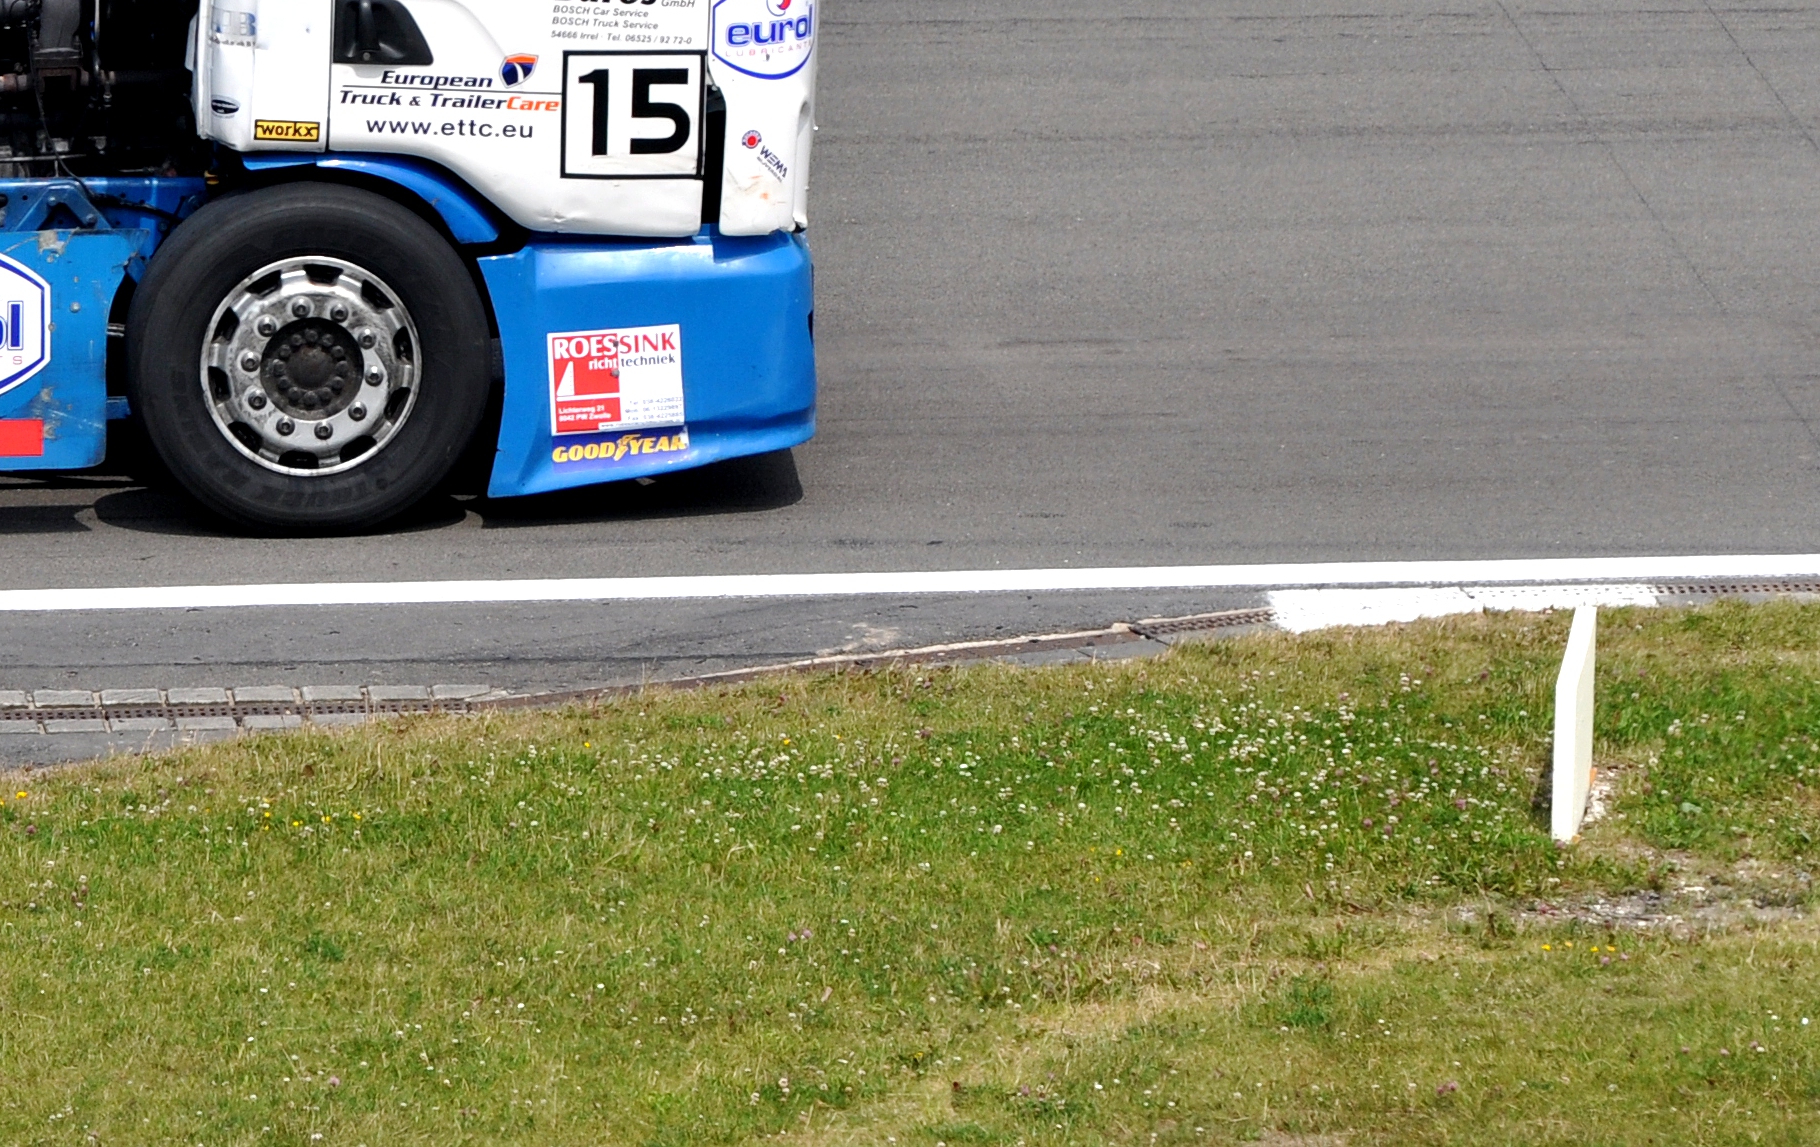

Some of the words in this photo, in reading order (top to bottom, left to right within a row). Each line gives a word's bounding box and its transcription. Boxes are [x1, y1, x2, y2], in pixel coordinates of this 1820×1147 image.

[552, 5, 590, 16] BOSCH
[593, 7, 610, 16] Car
[613, 8, 649, 18] Service
[551, 16, 589, 27] BOSCH
[592, 18, 619, 28] Truck
[622, 20, 659, 30] Service
[725, 2, 813, 47] eurol
[580, 31, 599, 40] Irrel
[380, 70, 493, 89] European
[340, 90, 402, 106] Truck
[409, 94, 421, 106] &
[577, 68, 691, 156] 15
[260, 122, 313, 138] workx
[366, 120, 534, 138] www.ettc.eu
[554, 332, 677, 360] ROESSINK
[552, 434, 688, 462] GOODYEAR
